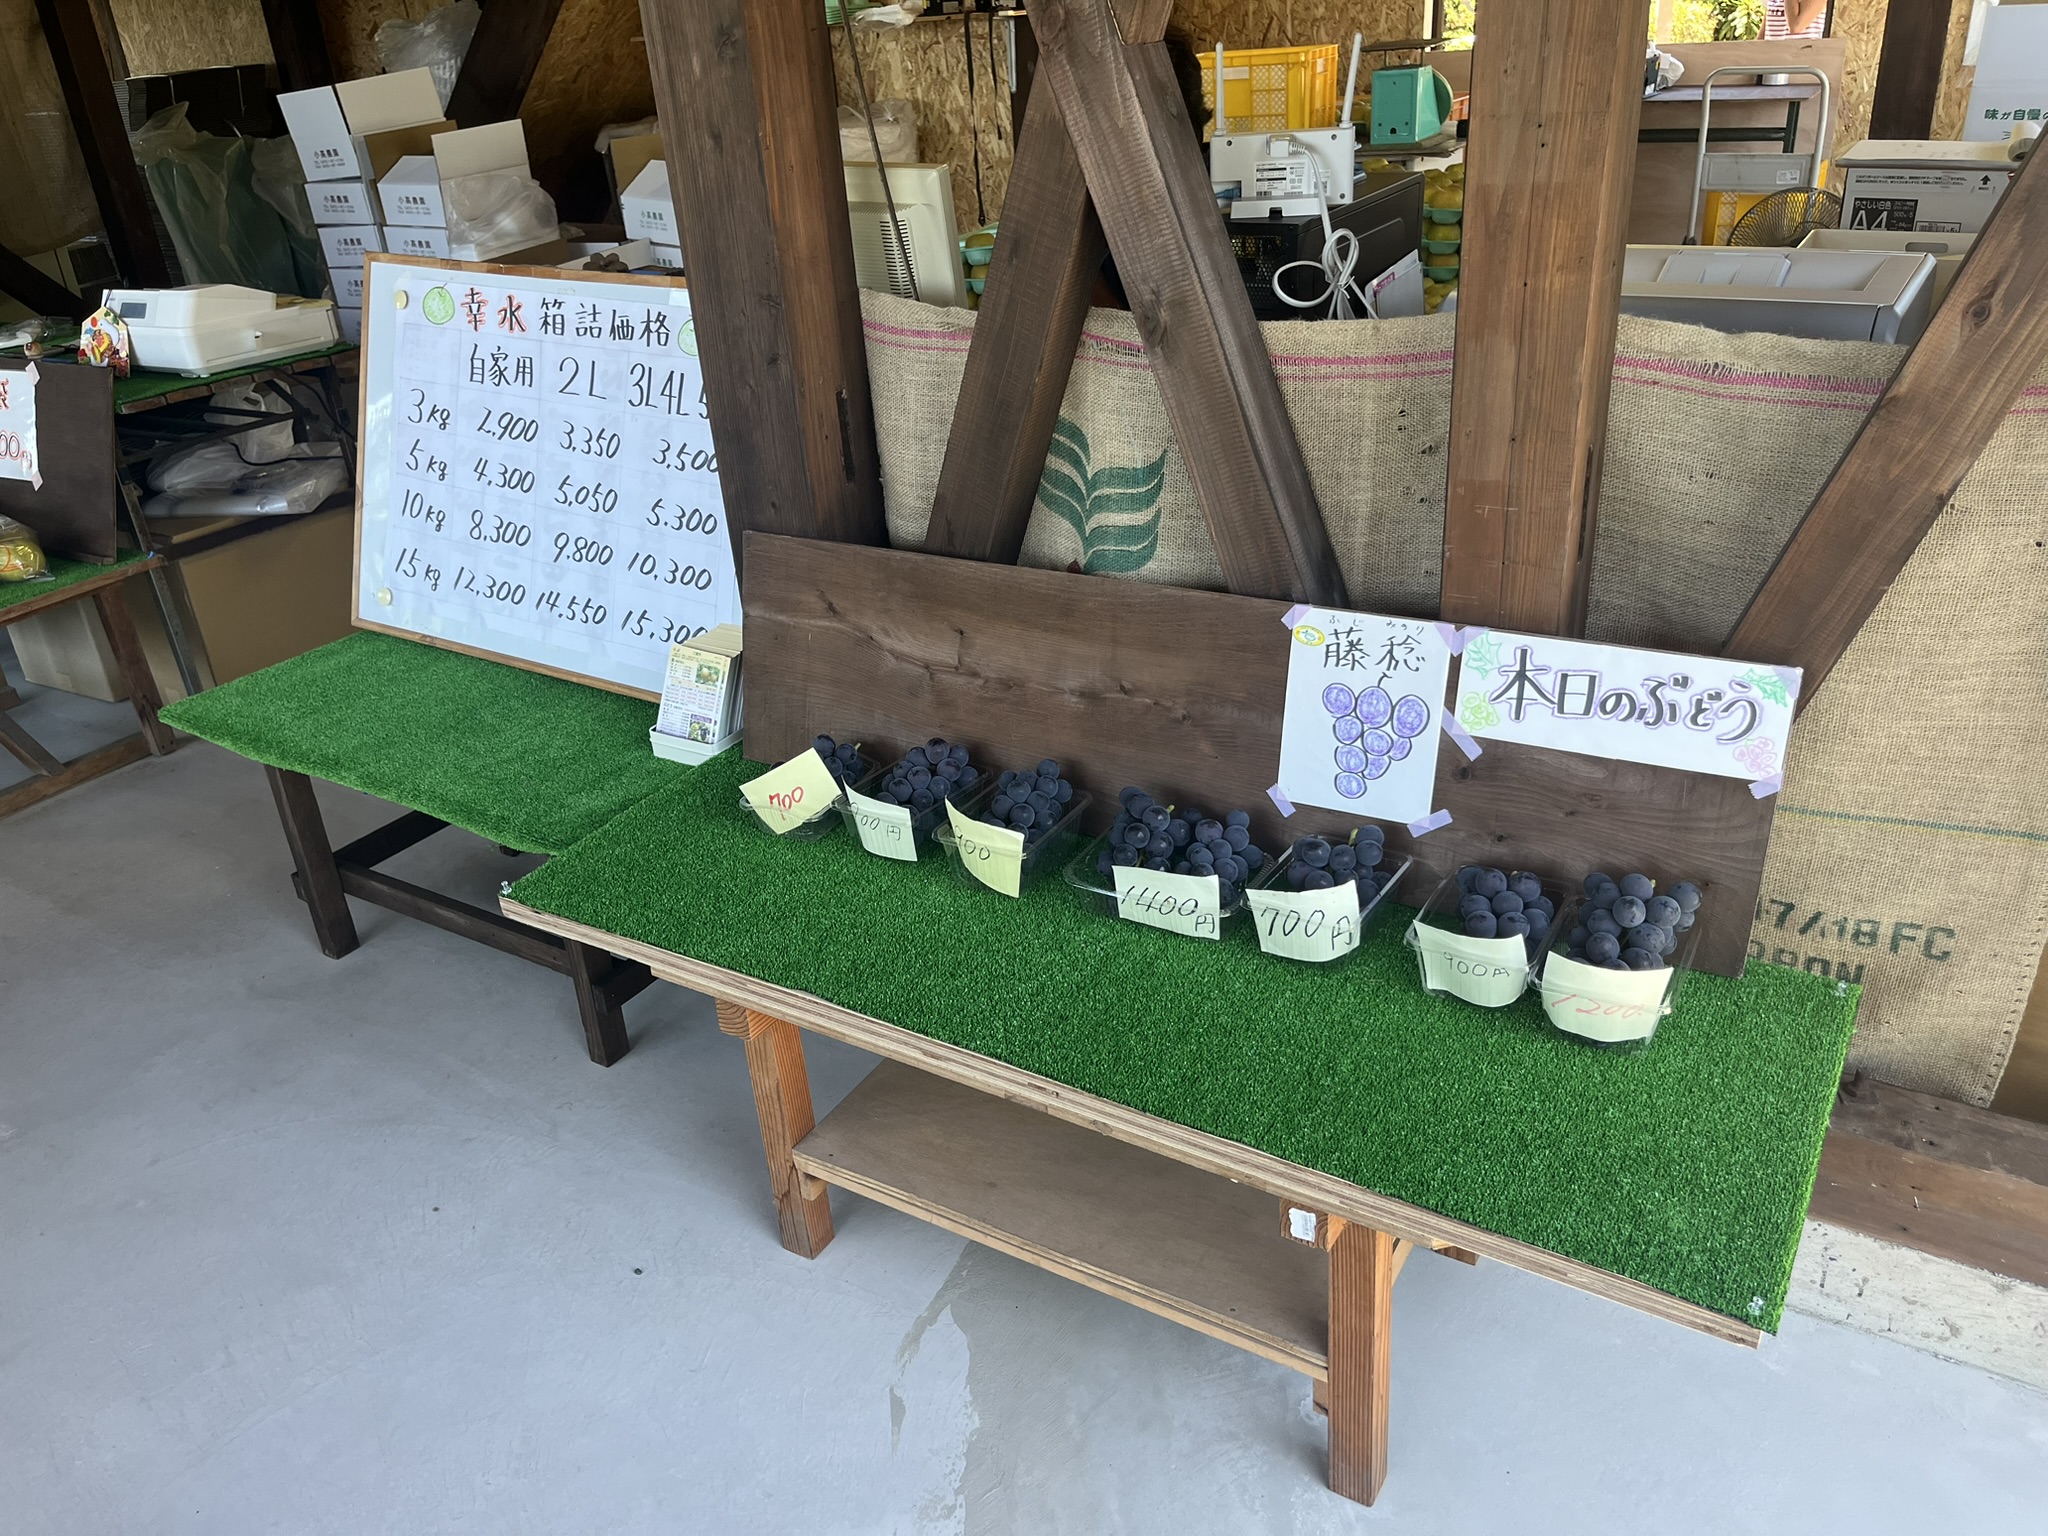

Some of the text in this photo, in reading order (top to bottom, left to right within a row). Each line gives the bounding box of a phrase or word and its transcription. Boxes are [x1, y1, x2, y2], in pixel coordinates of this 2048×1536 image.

[468, 343, 534, 388] 自家用
[558, 355, 607, 400] 2L
[1323, 626, 1426, 672] 藤稔
[1489, 645, 1760, 743] 本日のぶどう
[769, 786, 804, 821] 700
[1121, 885, 1216, 935] 1400円
